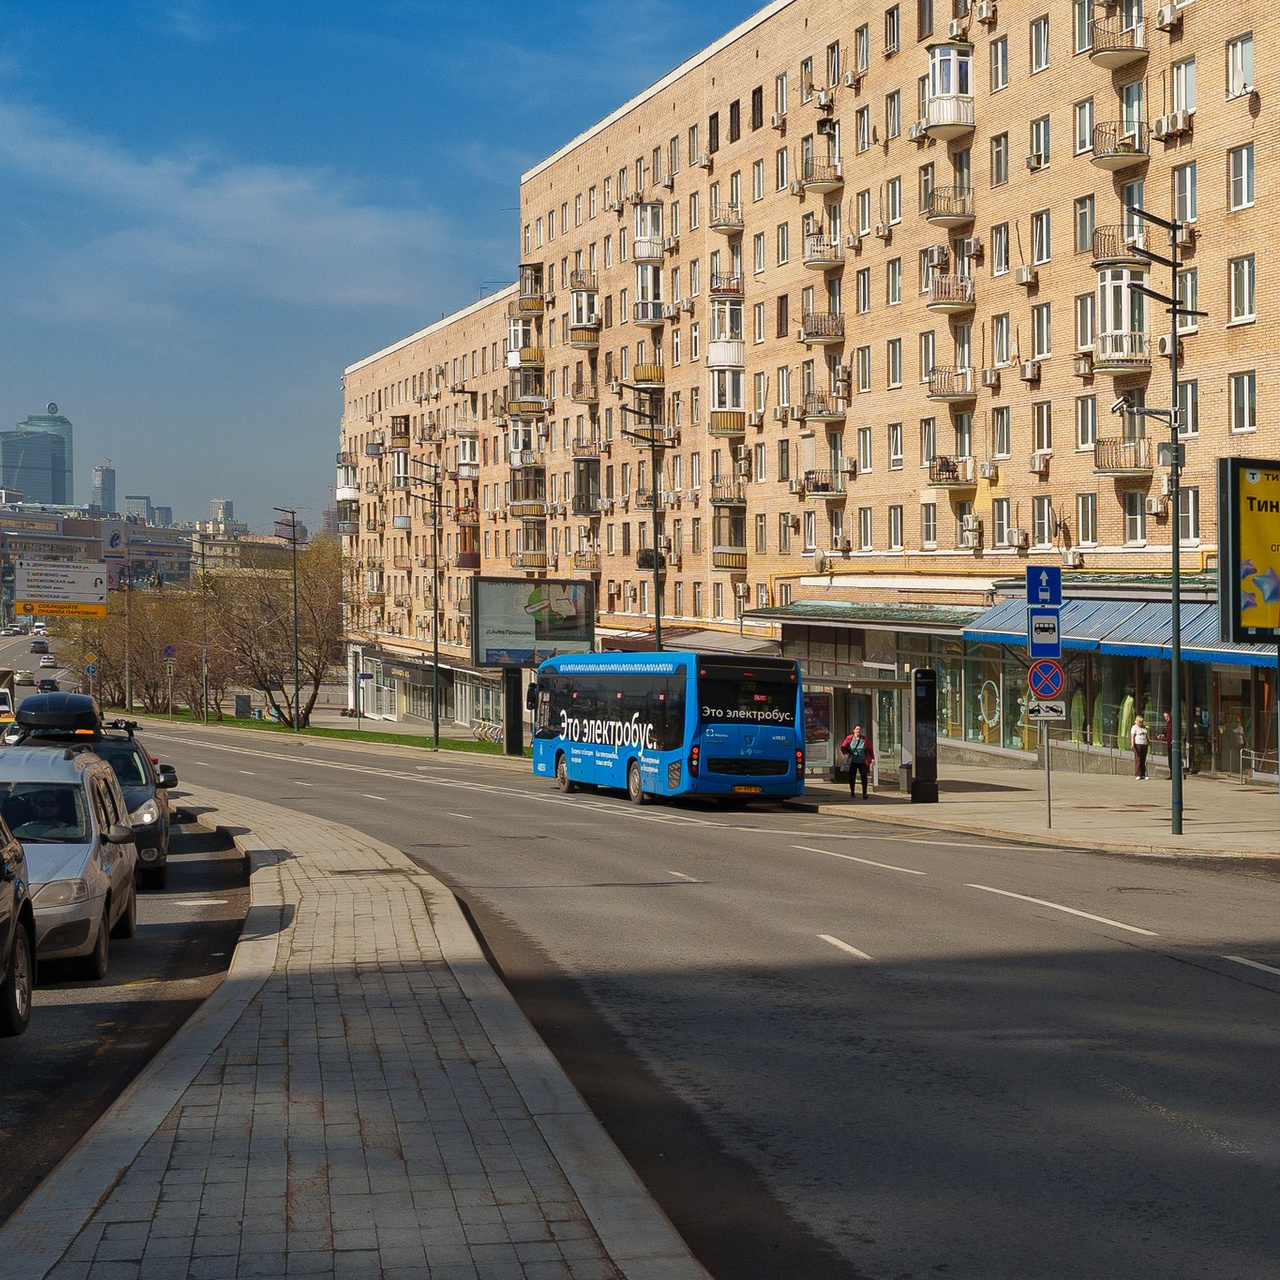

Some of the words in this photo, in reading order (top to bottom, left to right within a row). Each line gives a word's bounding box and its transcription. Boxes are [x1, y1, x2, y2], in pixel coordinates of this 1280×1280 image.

[702, 706, 723, 717] Это
[726, 709, 794, 722] электробус.
[560, 709, 580, 741] Это
[582, 711, 657, 757] электробус.
